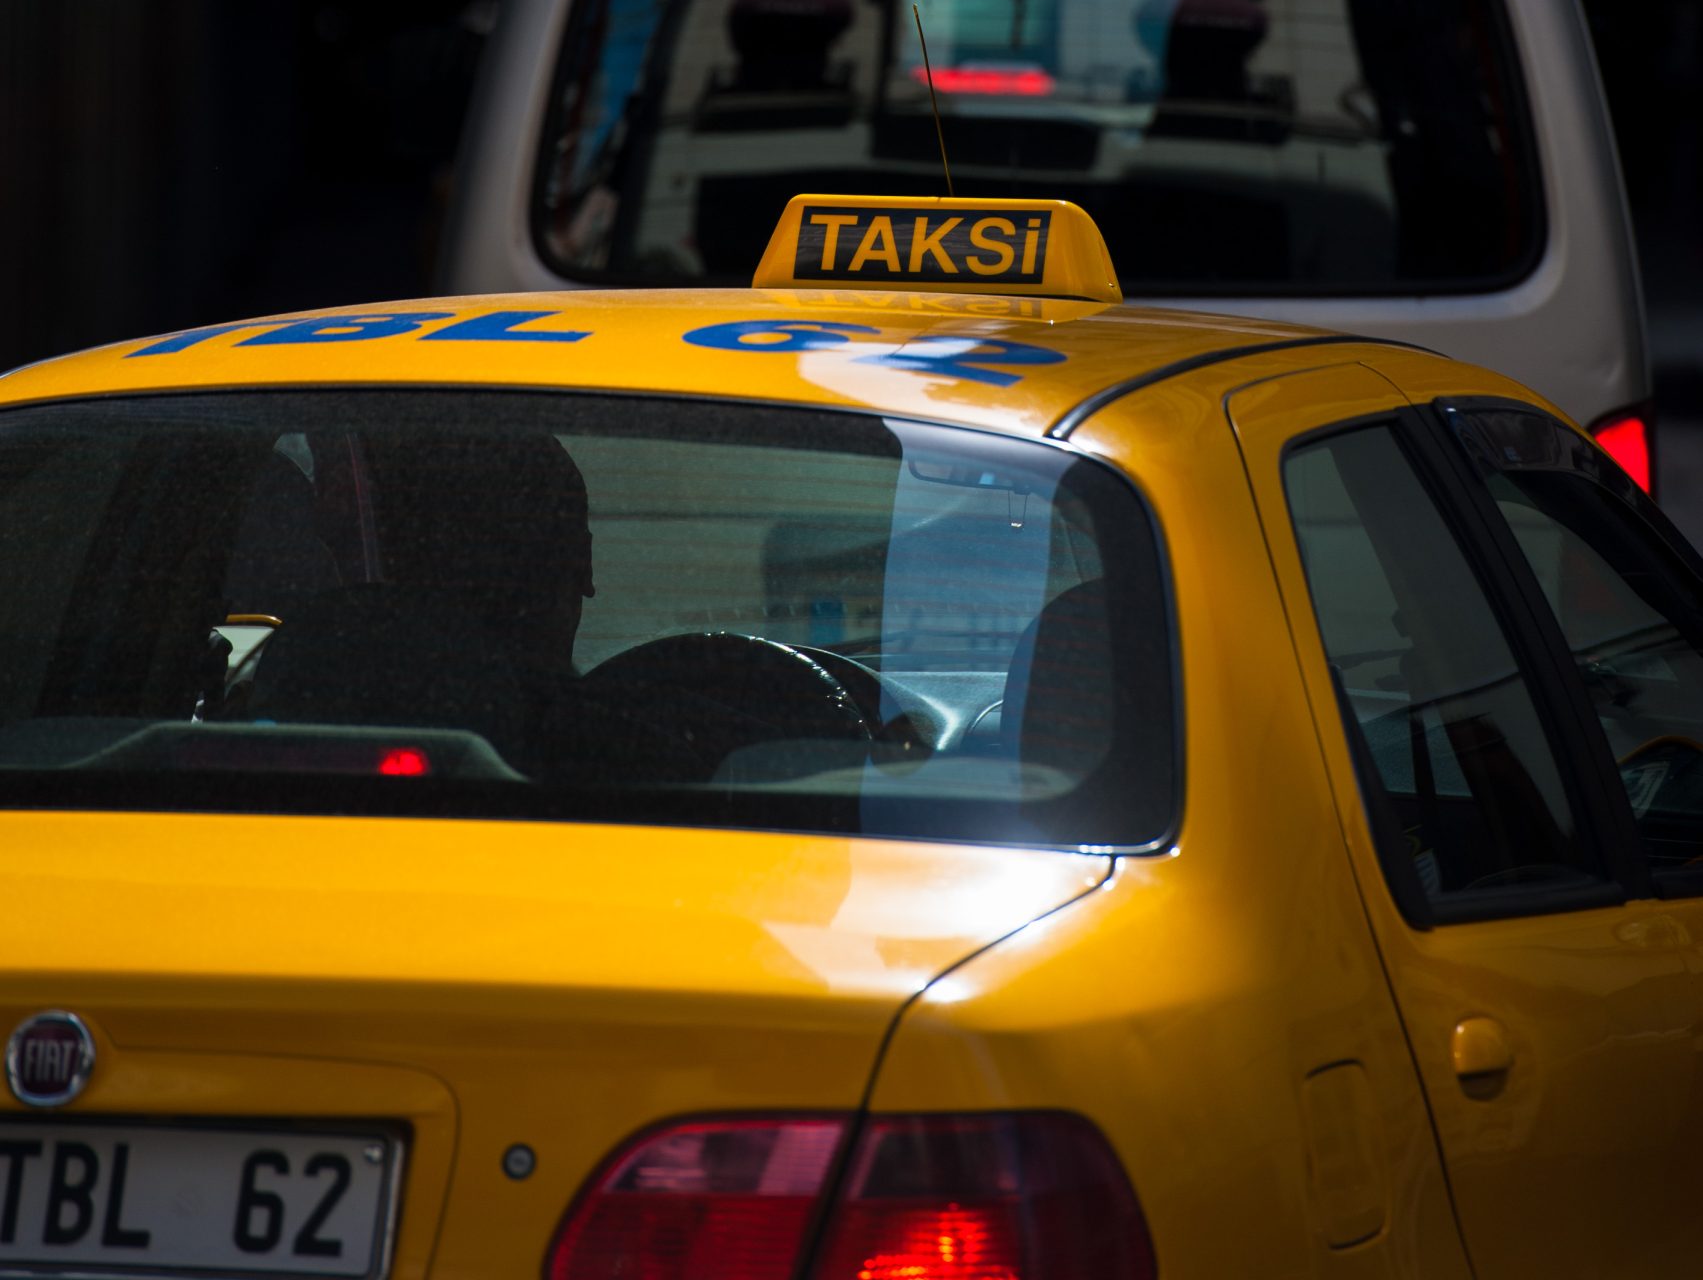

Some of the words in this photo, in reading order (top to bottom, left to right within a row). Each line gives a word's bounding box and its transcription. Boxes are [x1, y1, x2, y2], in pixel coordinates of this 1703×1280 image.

[122, 311, 595, 359] TBL
[682, 320, 1068, 387] 62
[23, 1039, 75, 1083] FIAT
[0, 1139, 151, 1249] TBL
[233, 1149, 352, 1258] 62
